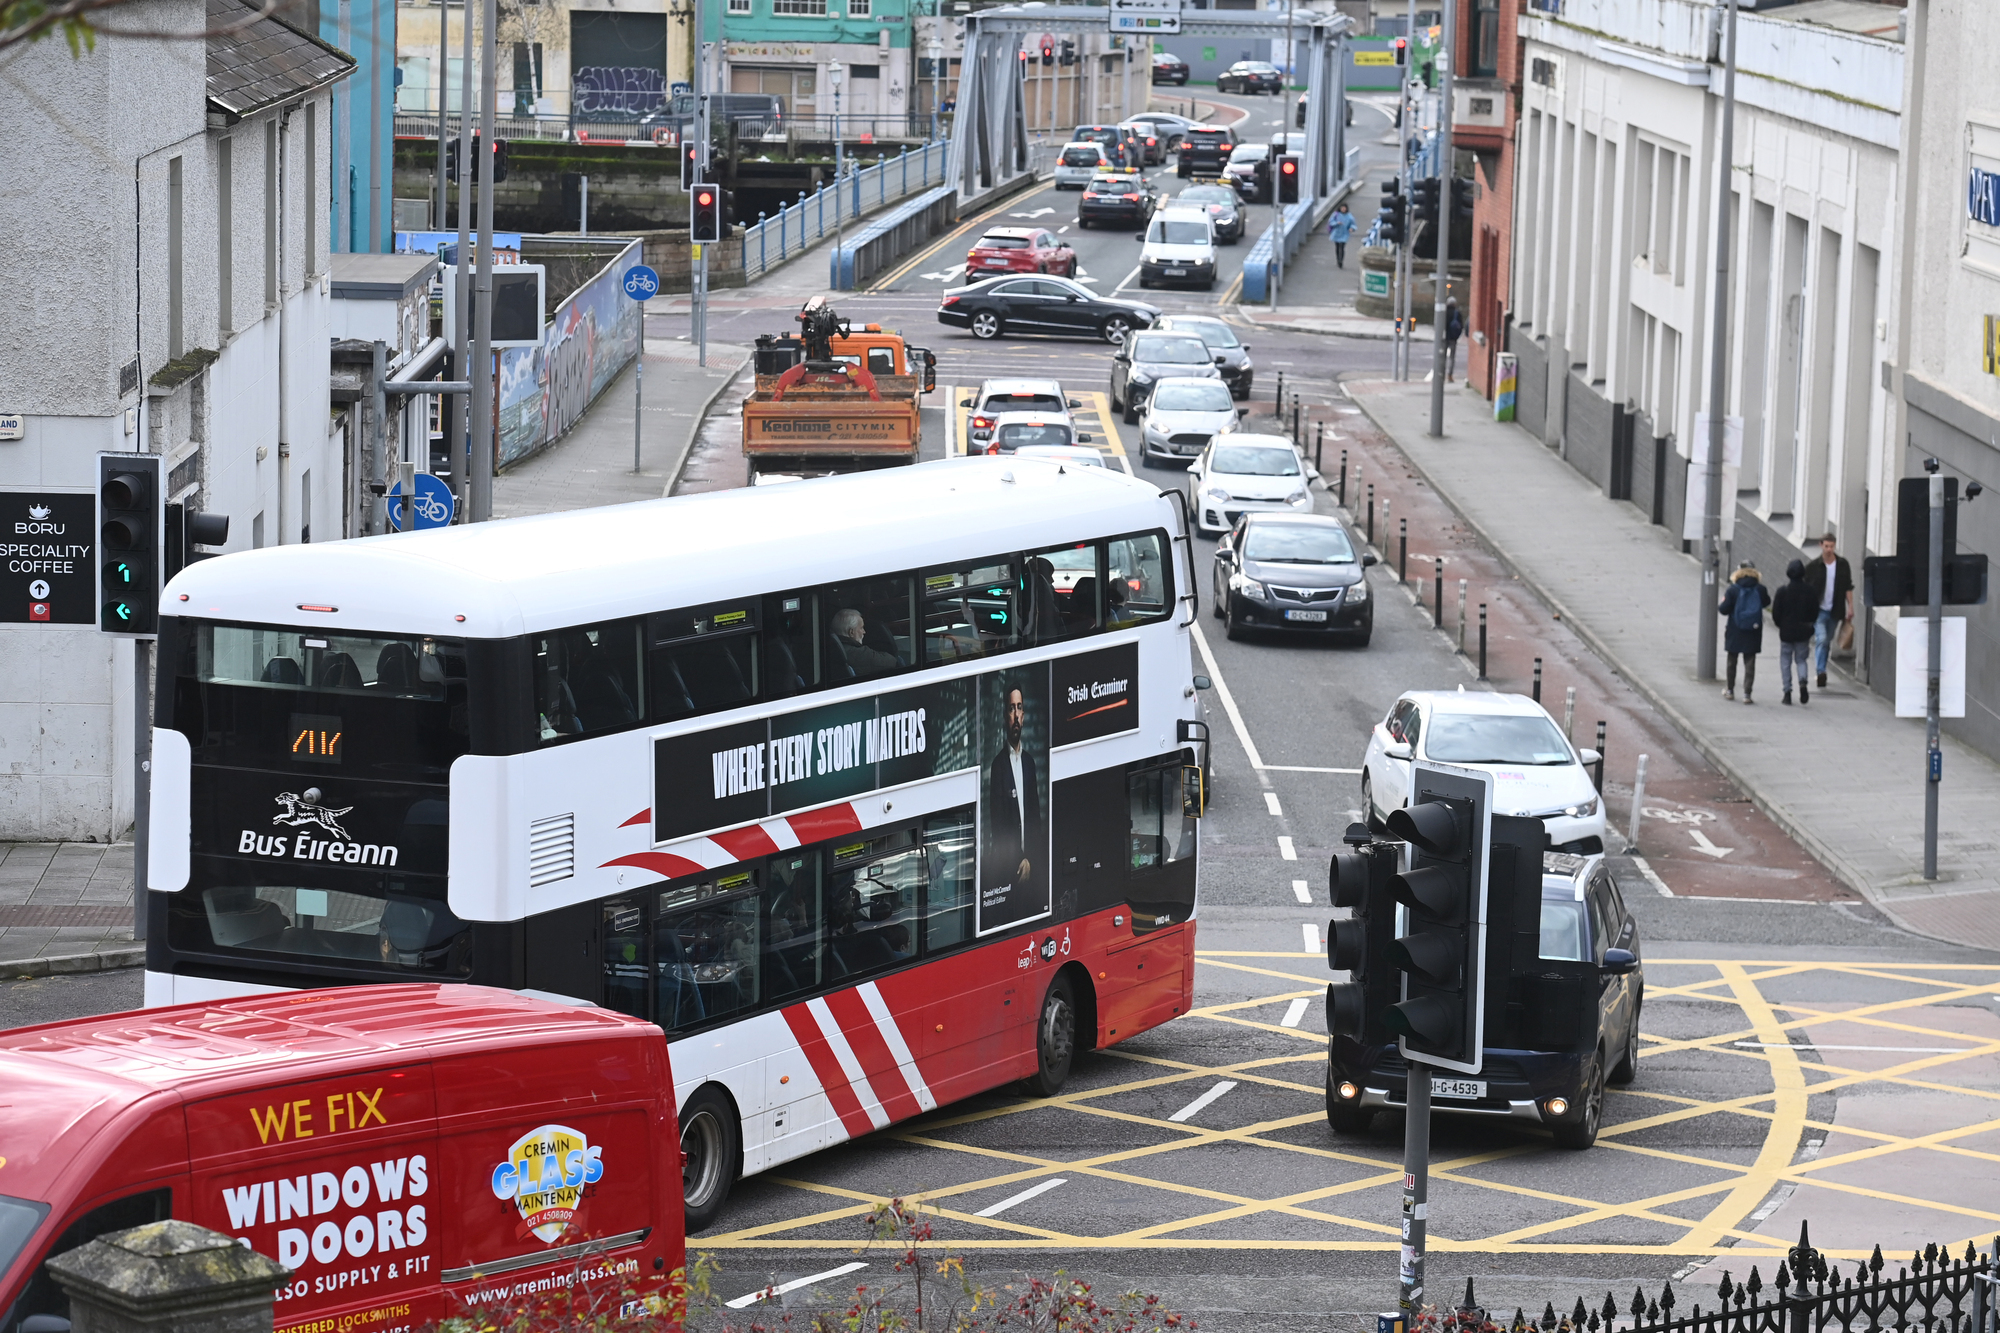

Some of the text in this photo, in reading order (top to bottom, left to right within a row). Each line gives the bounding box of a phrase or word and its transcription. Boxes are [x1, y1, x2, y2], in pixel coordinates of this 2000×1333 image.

[0, 420, 18, 429] AND
[762, 419, 896, 433] Keohane CITYMIX
[15, 522, 65, 535] BORU
[0, 543, 90, 558] SPECIALITY
[9, 560, 74, 574] COFFEE
[1068, 677, 1128, 704] Irish Examiner
[712, 707, 926, 800] WHERE EVERY STORY MATTERS
[238, 829, 399, 867] Bus Éireann
[1431, 1080, 1478, 1095] 1-G-4539
[249, 1087, 387, 1144] WE FIX
[524, 1138, 570, 1158] CREMIN
[491, 1145, 604, 1201] GLASS
[222, 1154, 428, 1230] WINDOWS
[501, 1185, 597, 1214] & MAINTENANCE
[527, 1214, 540, 1228] 021
[278, 1204, 428, 1271] DOORS
[274, 1255, 430, 1302] LSO SUPPLY & FIT
[465, 1258, 639, 1306] www.creminglass.com
[338, 1303, 411, 1328] LOCKSMITHS
